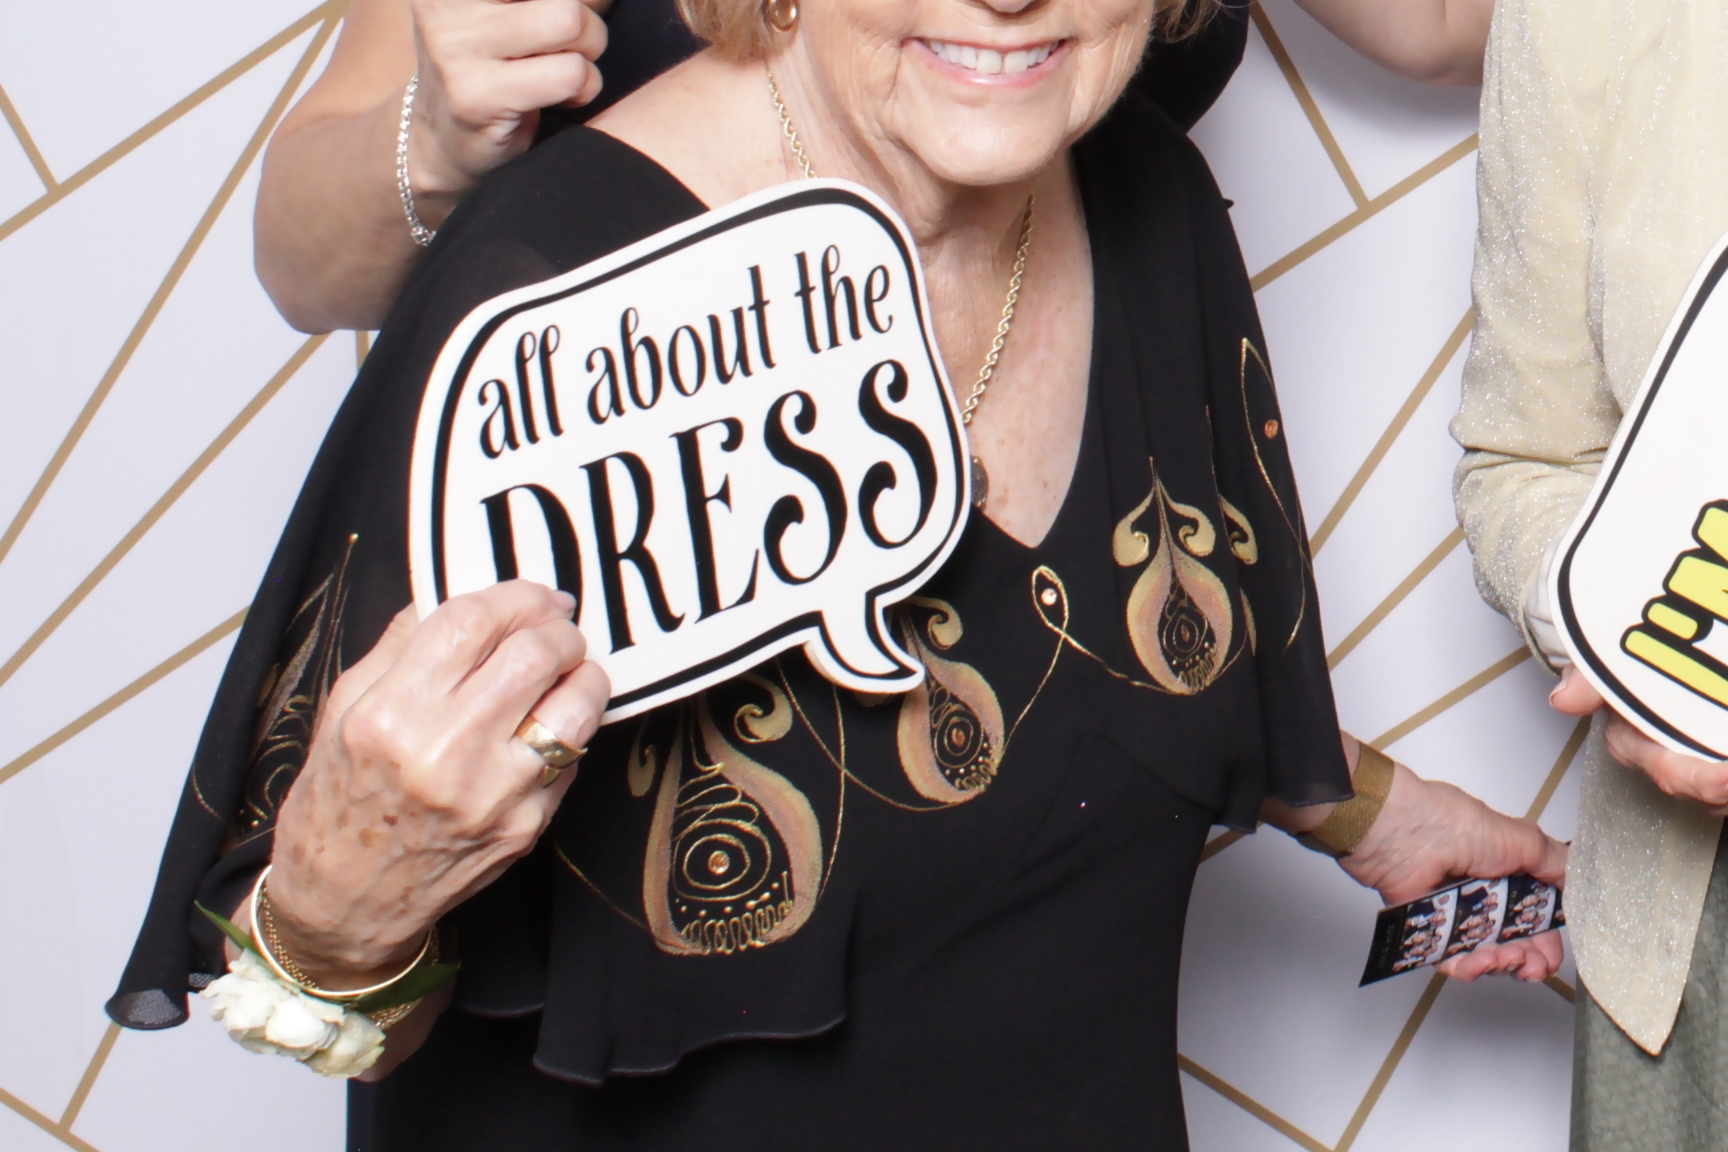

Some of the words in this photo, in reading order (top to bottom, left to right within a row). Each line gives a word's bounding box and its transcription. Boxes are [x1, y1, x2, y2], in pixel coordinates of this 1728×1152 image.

[478, 325, 564, 459] all
[585, 265, 776, 425] about
[794, 245, 893, 354] the
[479, 359, 938, 655] DRESS
